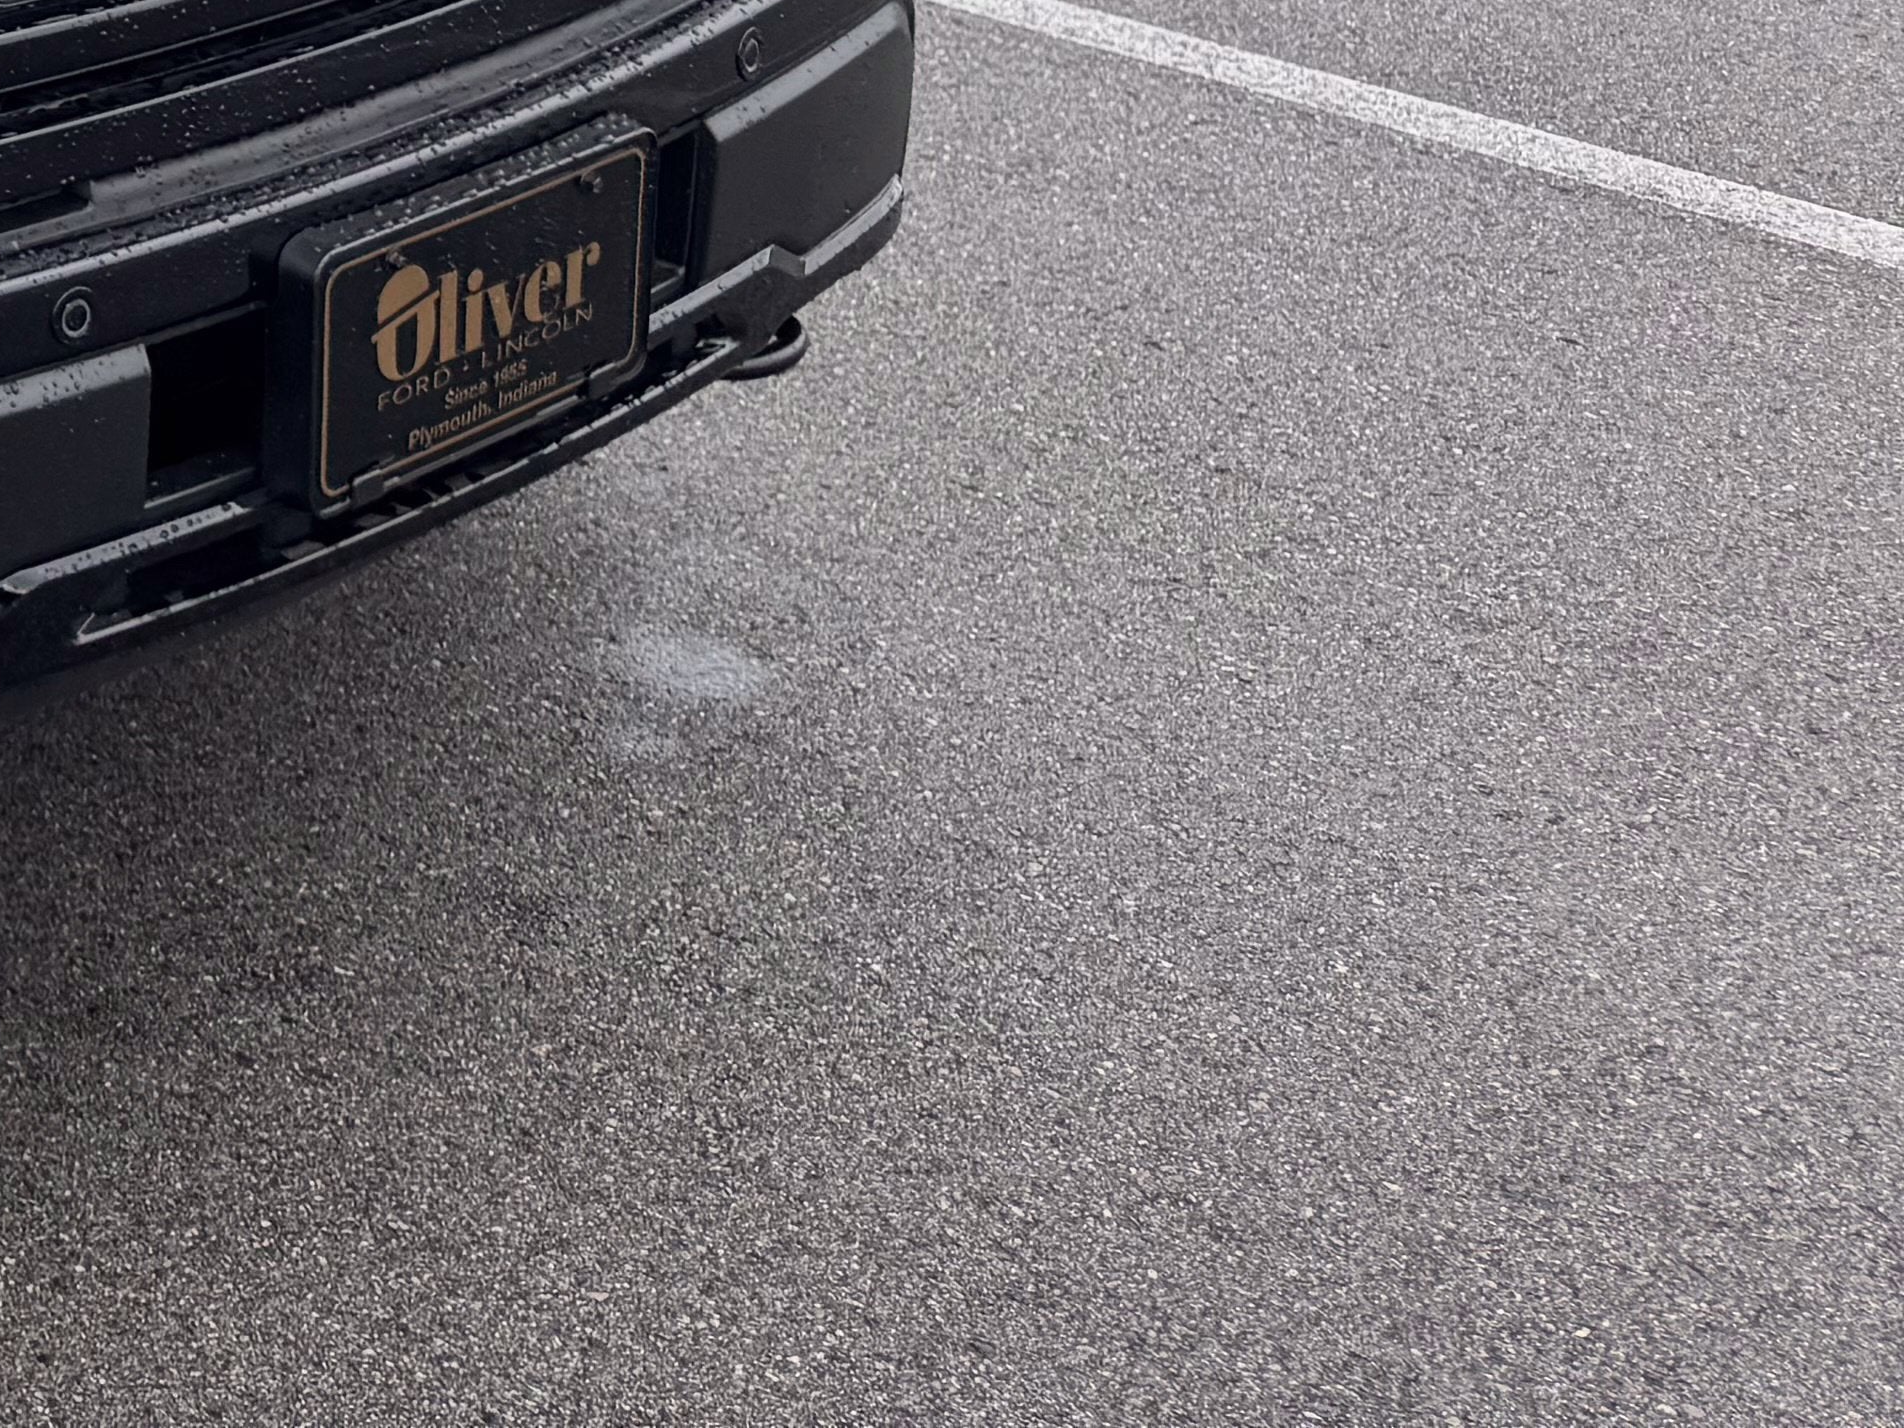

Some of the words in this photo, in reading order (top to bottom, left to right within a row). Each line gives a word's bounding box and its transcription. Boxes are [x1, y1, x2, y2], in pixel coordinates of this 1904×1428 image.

[371, 240, 601, 383] Oliver
[376, 363, 452, 412] FORD
[480, 302, 595, 369] LINCOLN
[444, 379, 489, 410] Since
[498, 370, 558, 410] Indiana
